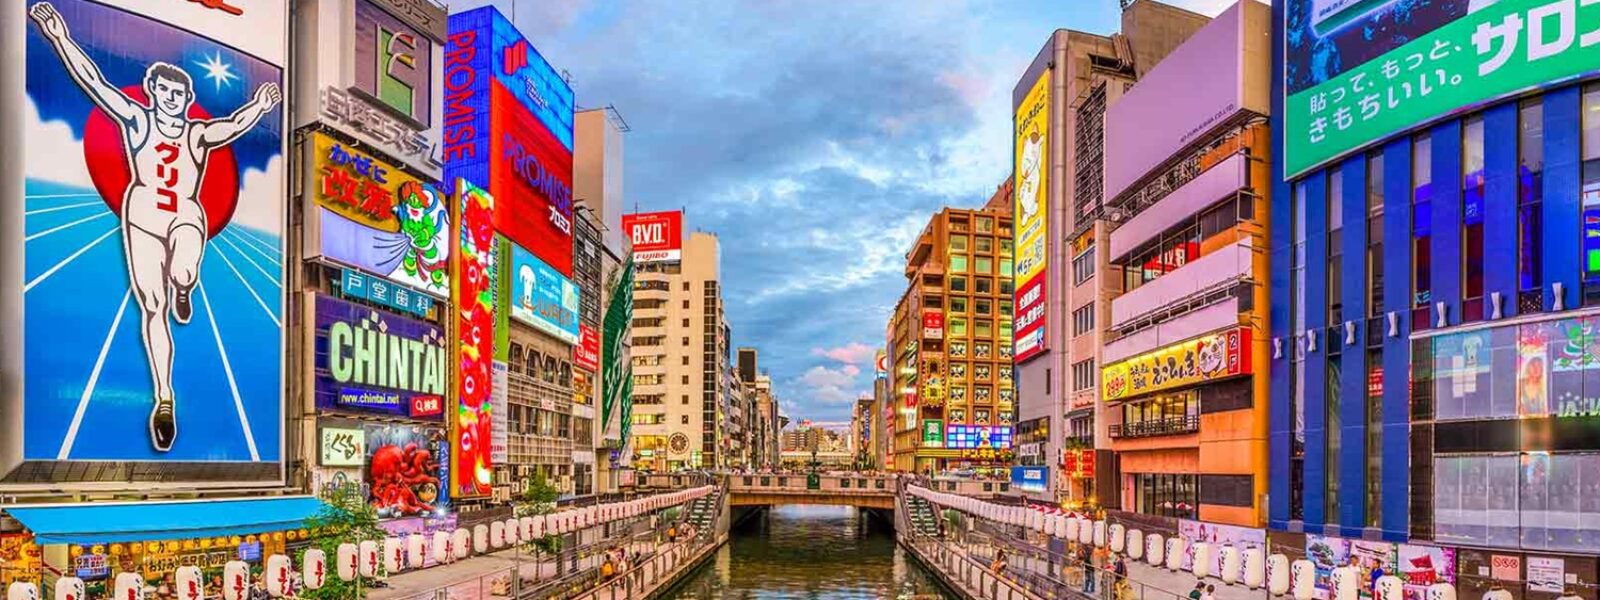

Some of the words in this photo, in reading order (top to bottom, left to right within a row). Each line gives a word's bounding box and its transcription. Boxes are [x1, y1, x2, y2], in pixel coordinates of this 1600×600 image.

[444, 30, 477, 160] PROMISE
[1309, 69, 1462, 143] きもちいい。
[1310, 40, 1462, 115] 貼って、もっと、
[154, 141, 182, 213] グリコ
[328, 144, 388, 184] かぜに
[503, 132, 571, 216] PROMISE
[633, 223, 665, 245] B.V.D.
[331, 321, 446, 396] CHINTAI
